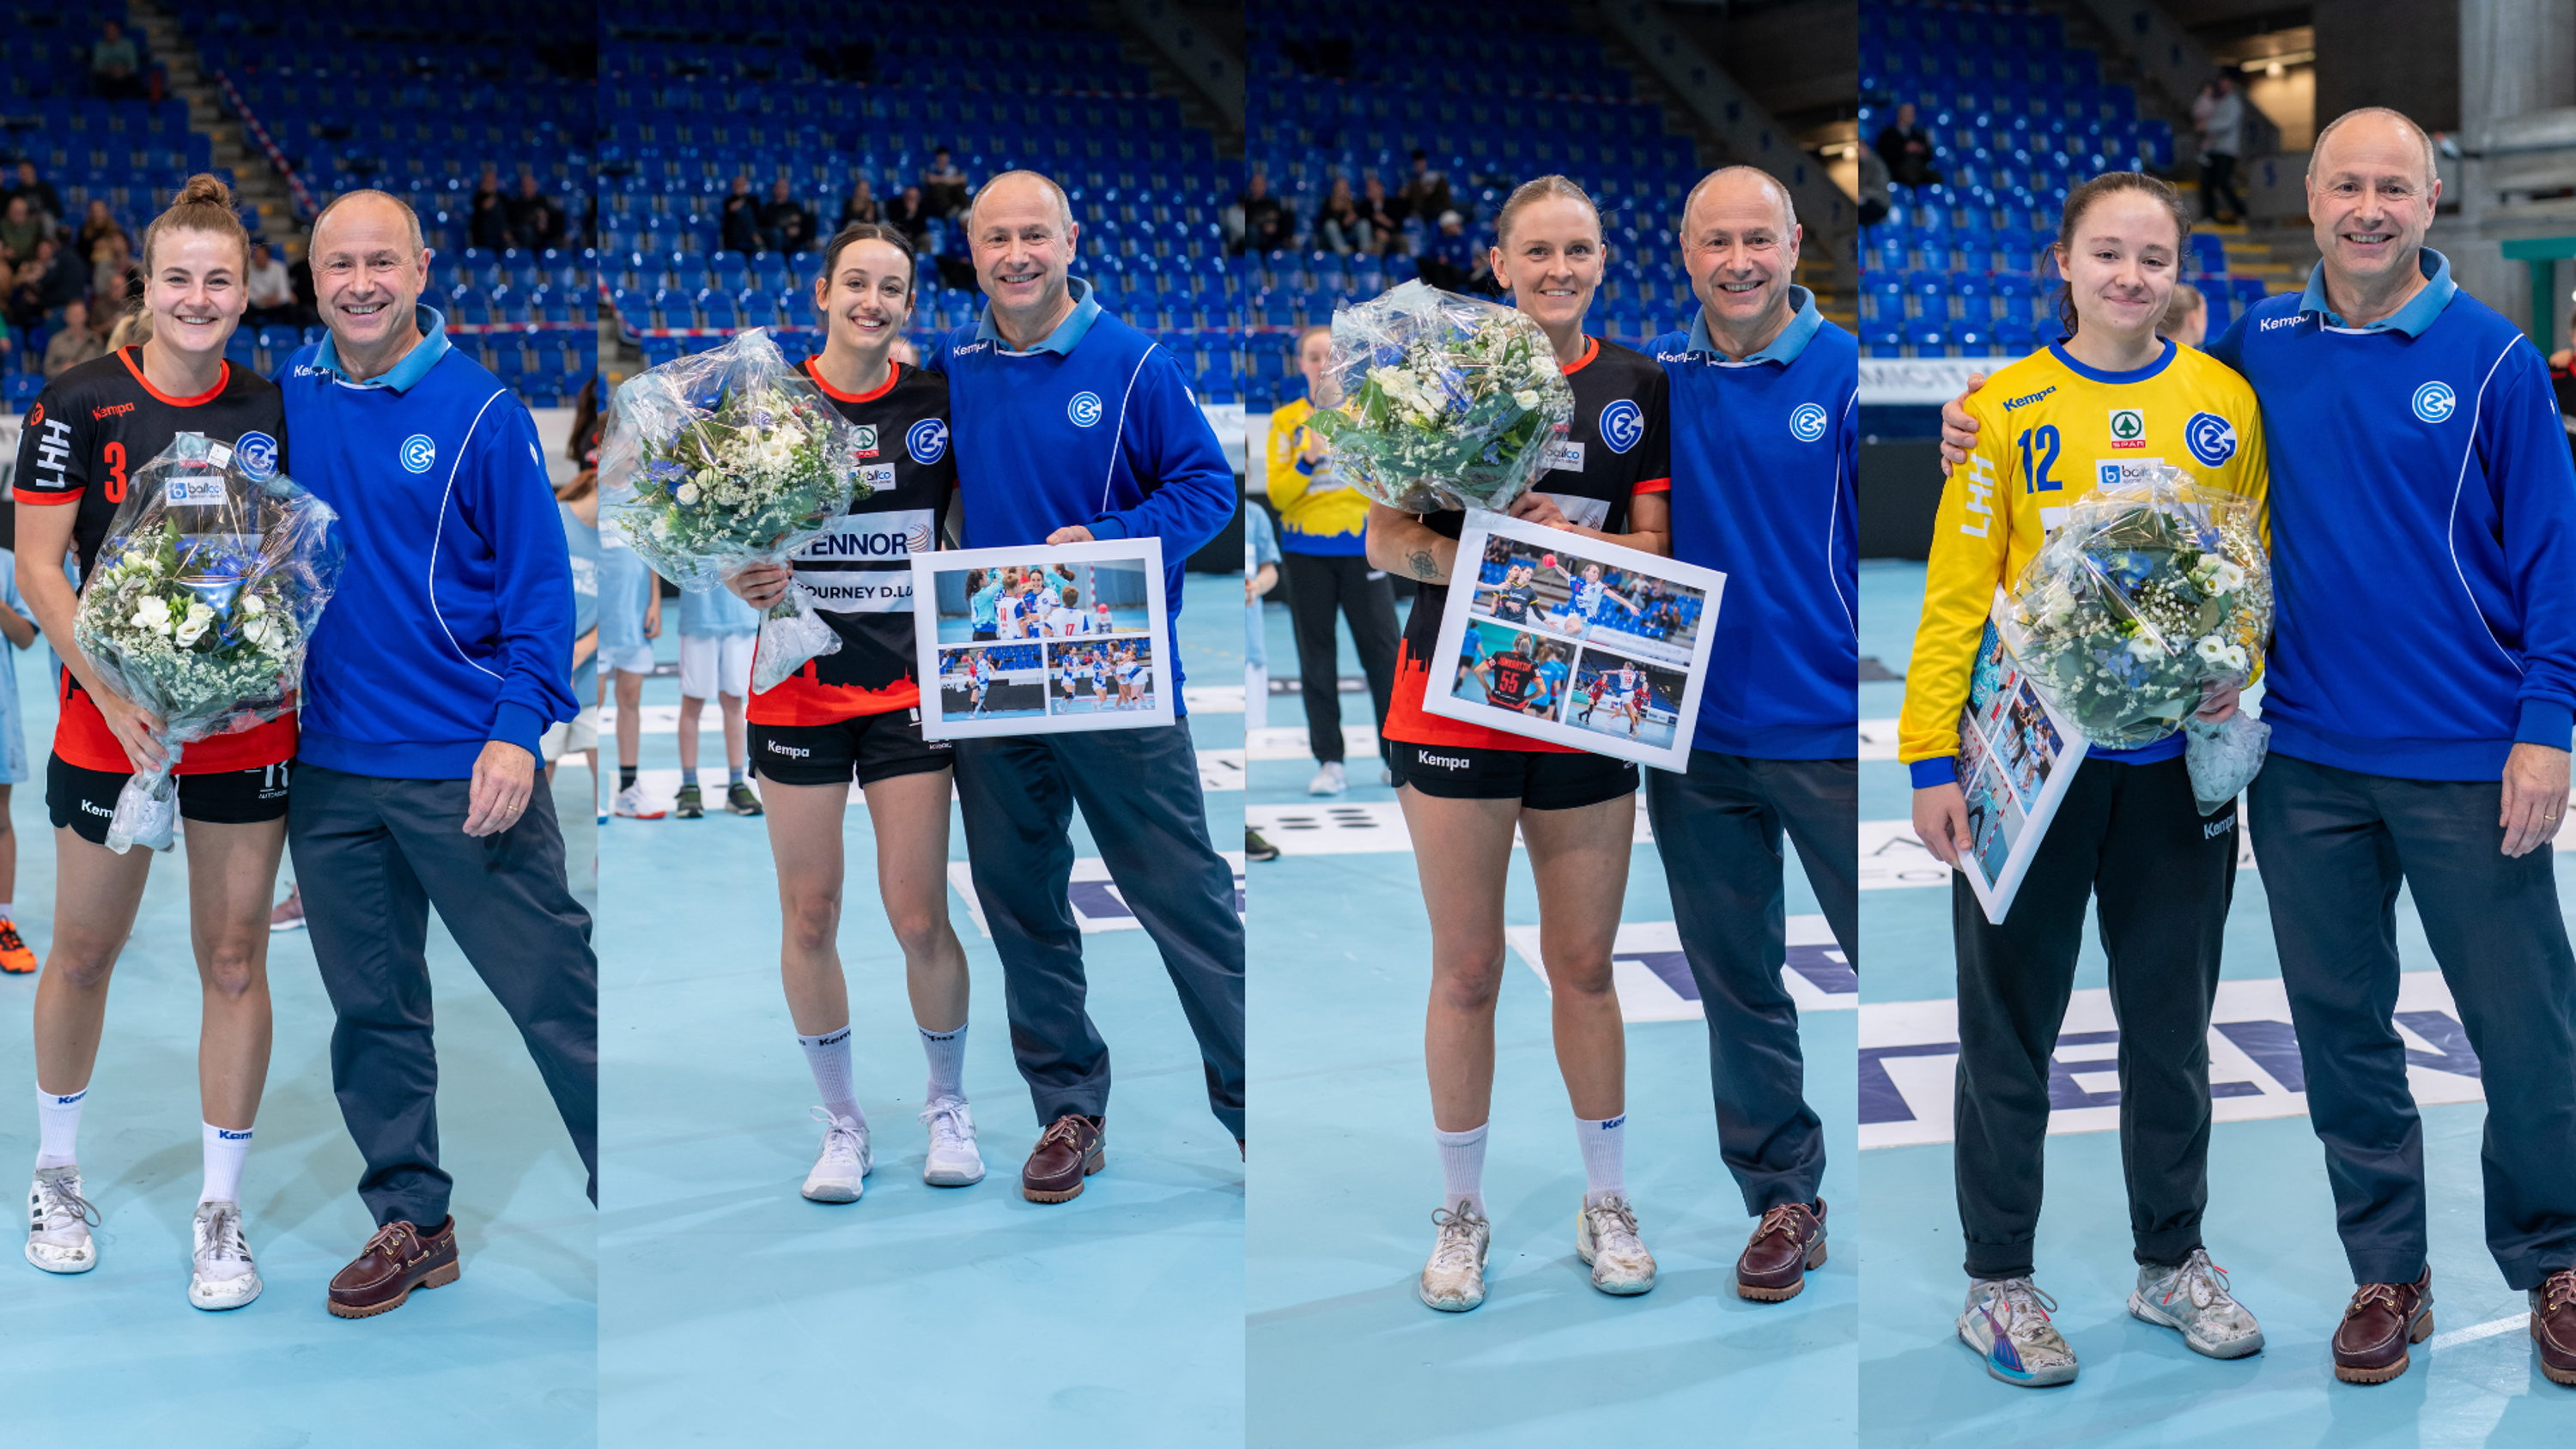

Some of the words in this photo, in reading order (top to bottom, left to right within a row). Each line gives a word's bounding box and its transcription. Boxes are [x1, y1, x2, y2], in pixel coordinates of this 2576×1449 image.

[2002, 385, 2057, 413] Kempa
[92, 402, 135, 421] Kempa
[35, 418, 72, 489] LHH
[2017, 424, 2063, 494] 12
[104, 440, 128, 504] 3
[1959, 452, 1995, 539] LHH
[801, 533, 908, 556] ENNOR
[797, 583, 875, 599] OURNEY
[1498, 670, 1520, 694] 55
[768, 739, 810, 760] Kempa
[1418, 749, 1470, 771] Kempa
[81, 799, 113, 818] Kem
[220, 1129, 252, 1141] Kem
